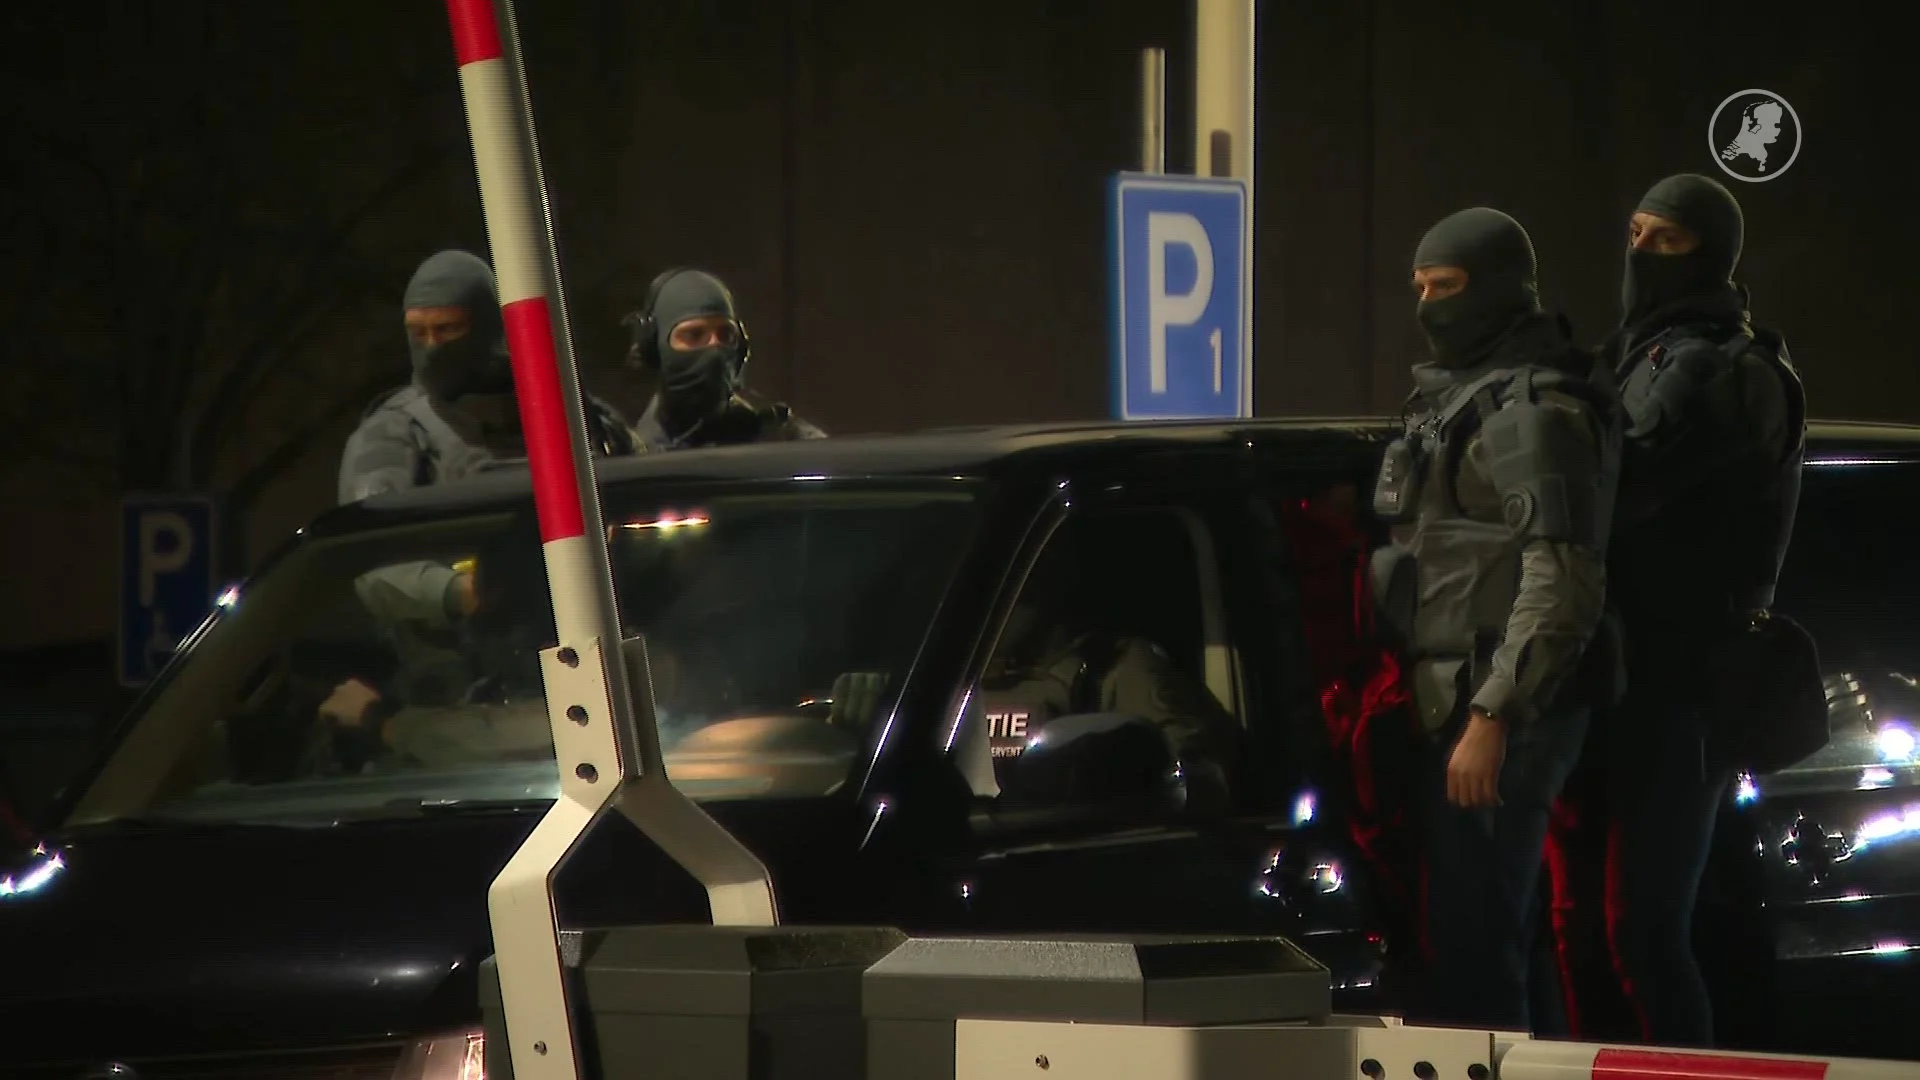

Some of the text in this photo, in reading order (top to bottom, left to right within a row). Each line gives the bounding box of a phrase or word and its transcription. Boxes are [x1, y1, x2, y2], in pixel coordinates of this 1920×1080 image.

[1148, 211, 1223, 396] P 1
[139, 511, 193, 608] P
[985, 713, 1029, 738] TIE
